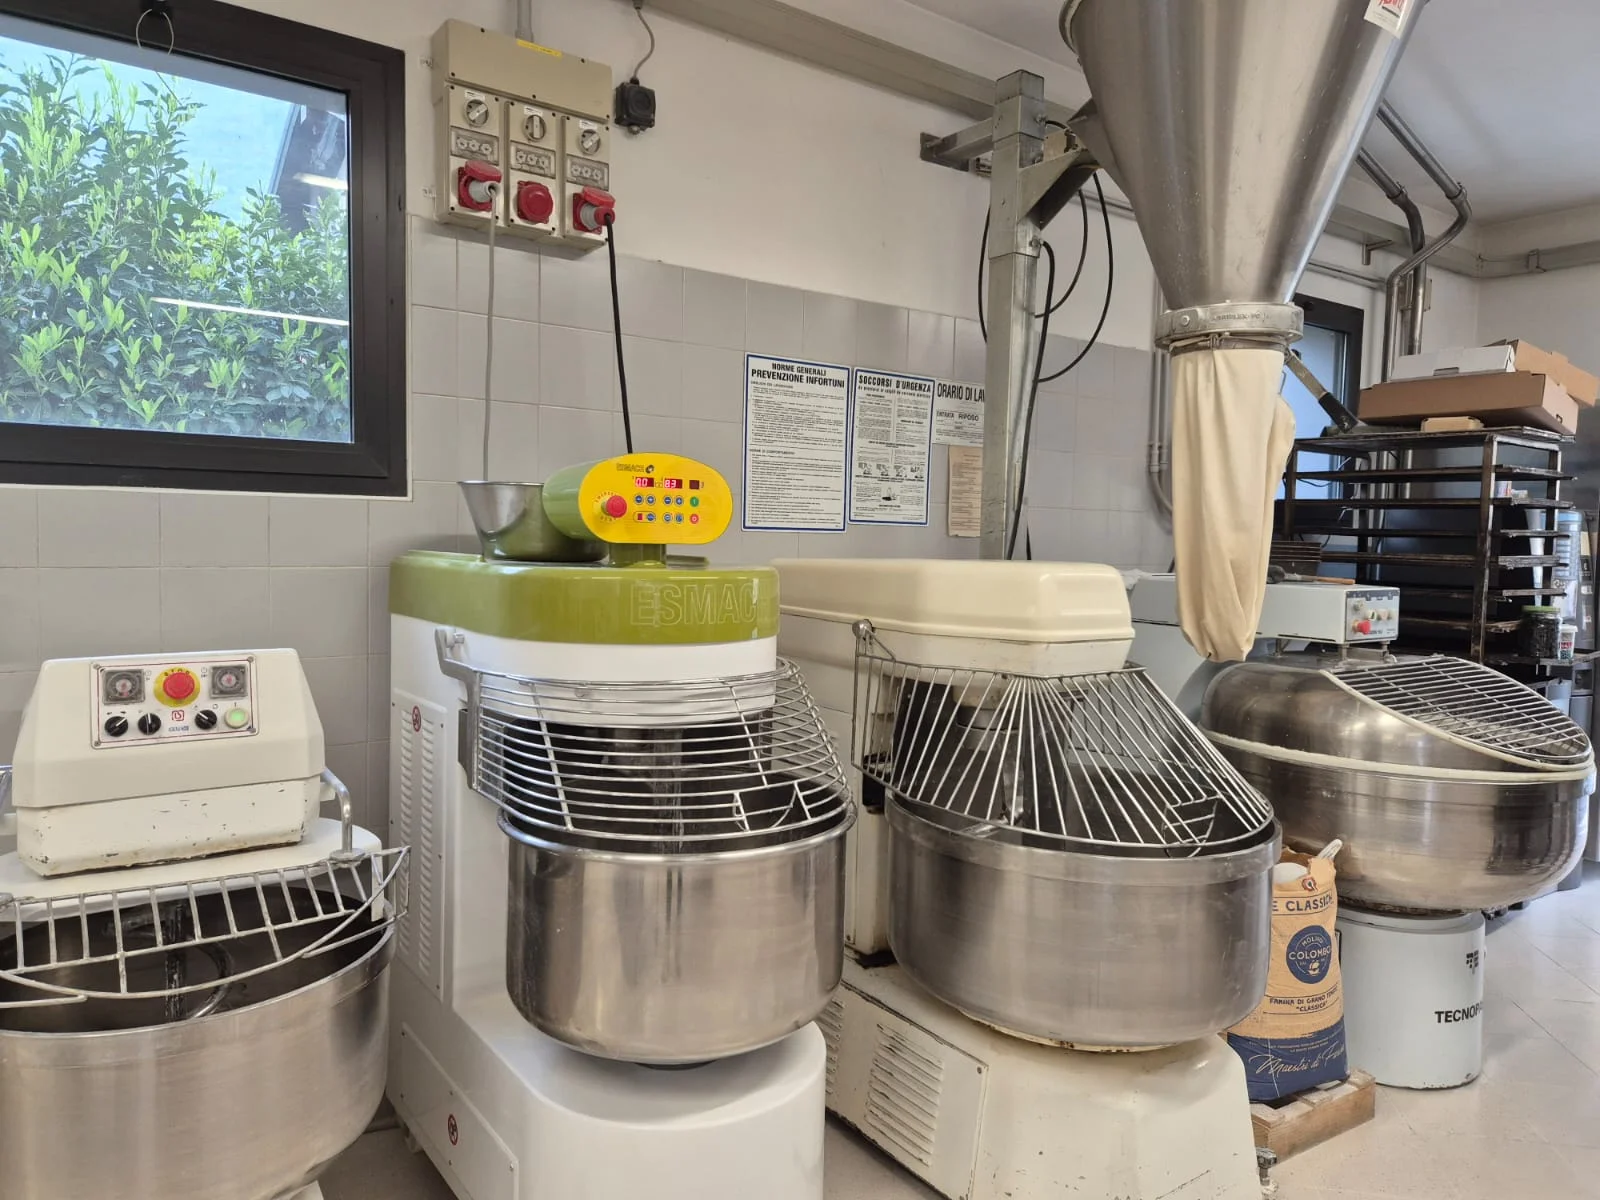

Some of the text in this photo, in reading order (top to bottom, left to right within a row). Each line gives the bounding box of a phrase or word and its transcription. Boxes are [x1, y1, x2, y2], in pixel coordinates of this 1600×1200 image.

[772, 363, 826, 376] NORME GENERALI
[751, 369, 804, 383] PREVENZIONE
[806, 376, 845, 388] INFORTUNI
[858, 375, 892, 388] SOCCORSI
[896, 380, 931, 393] D'URGENZA
[937, 382, 963, 400] ORARIO
[965, 387, 972, 401] DI
[958, 413, 979, 421] RIPOSO
[664, 479, 677, 489] 83
[1288, 945, 1331, 960] COLOMBO
[1434, 1001, 1484, 1024] TECNOP
